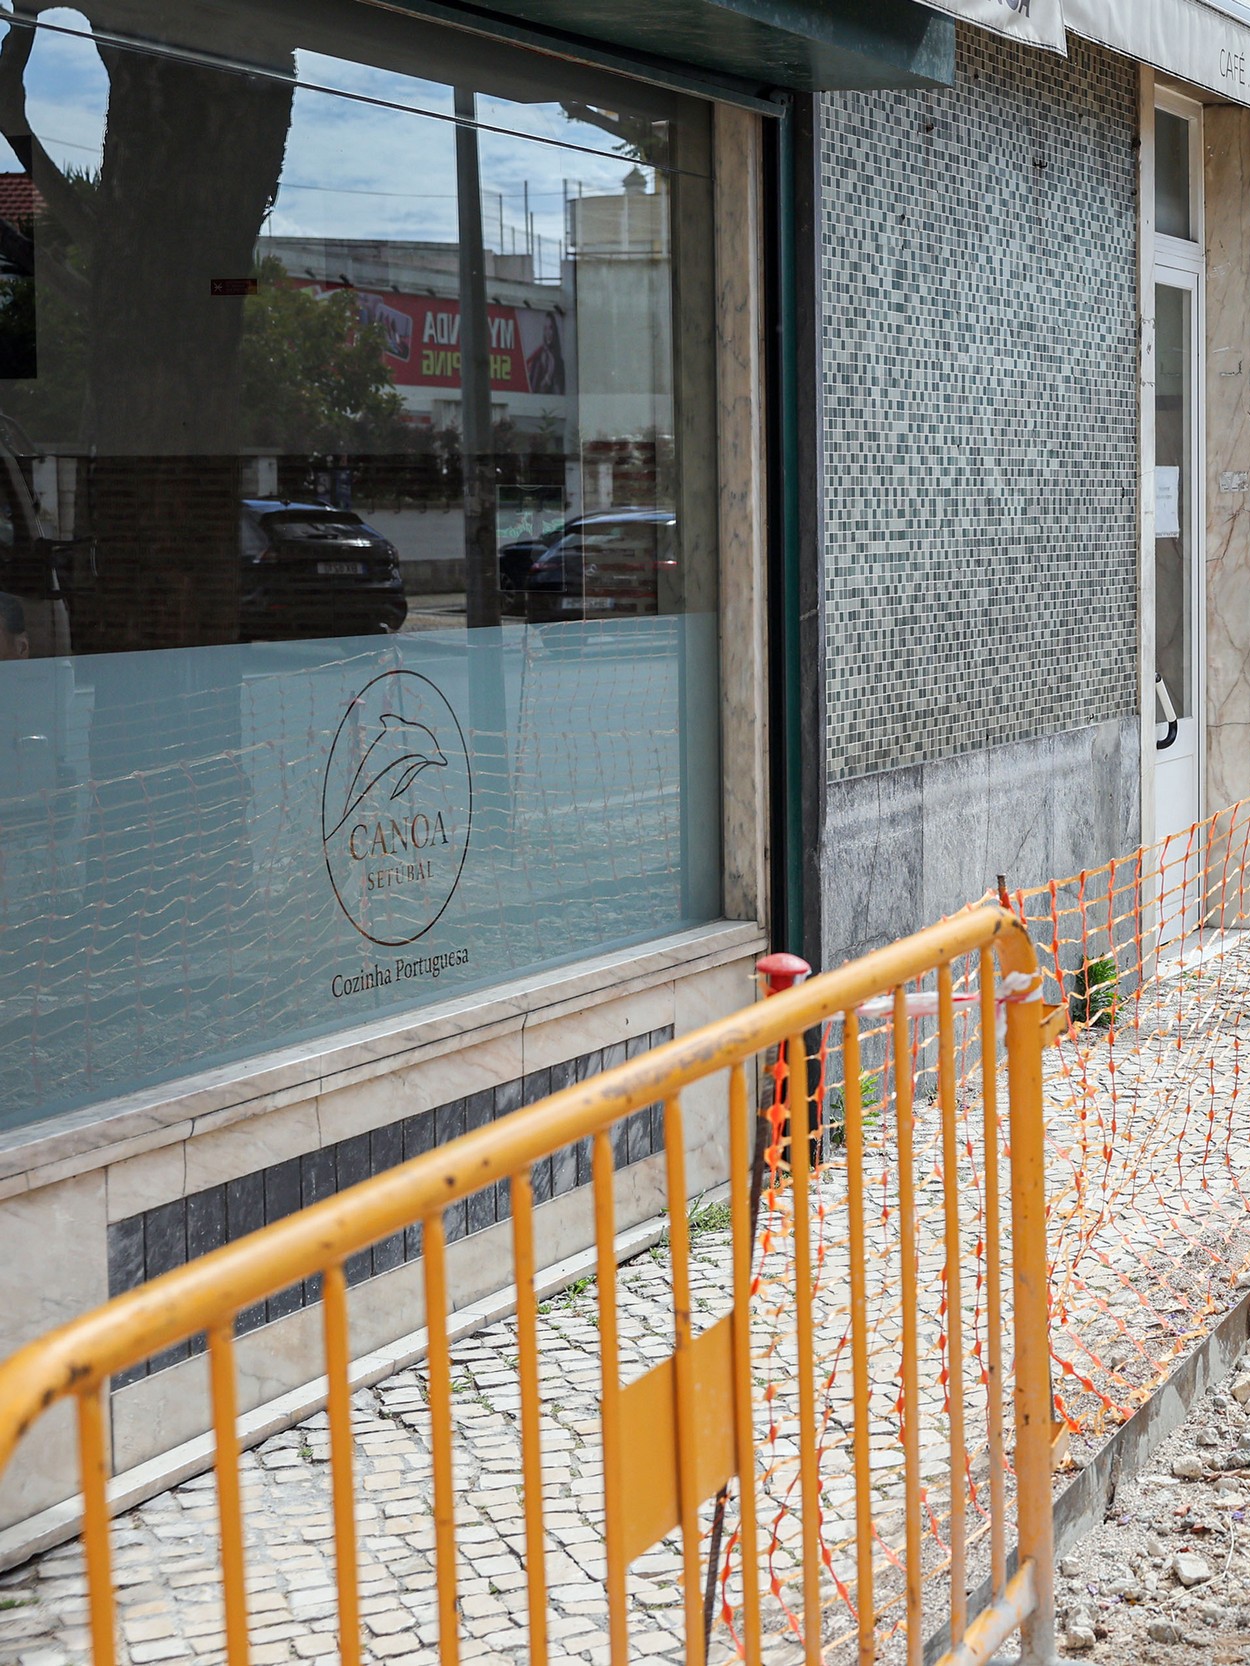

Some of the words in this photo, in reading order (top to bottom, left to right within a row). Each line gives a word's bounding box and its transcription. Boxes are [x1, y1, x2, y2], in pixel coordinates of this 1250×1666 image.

[1219, 49, 1245, 85] CAFÉ
[350, 811, 449, 861] CANOA
[331, 964, 392, 998] Cozinha
[395, 948, 469, 982] Portuguesa
